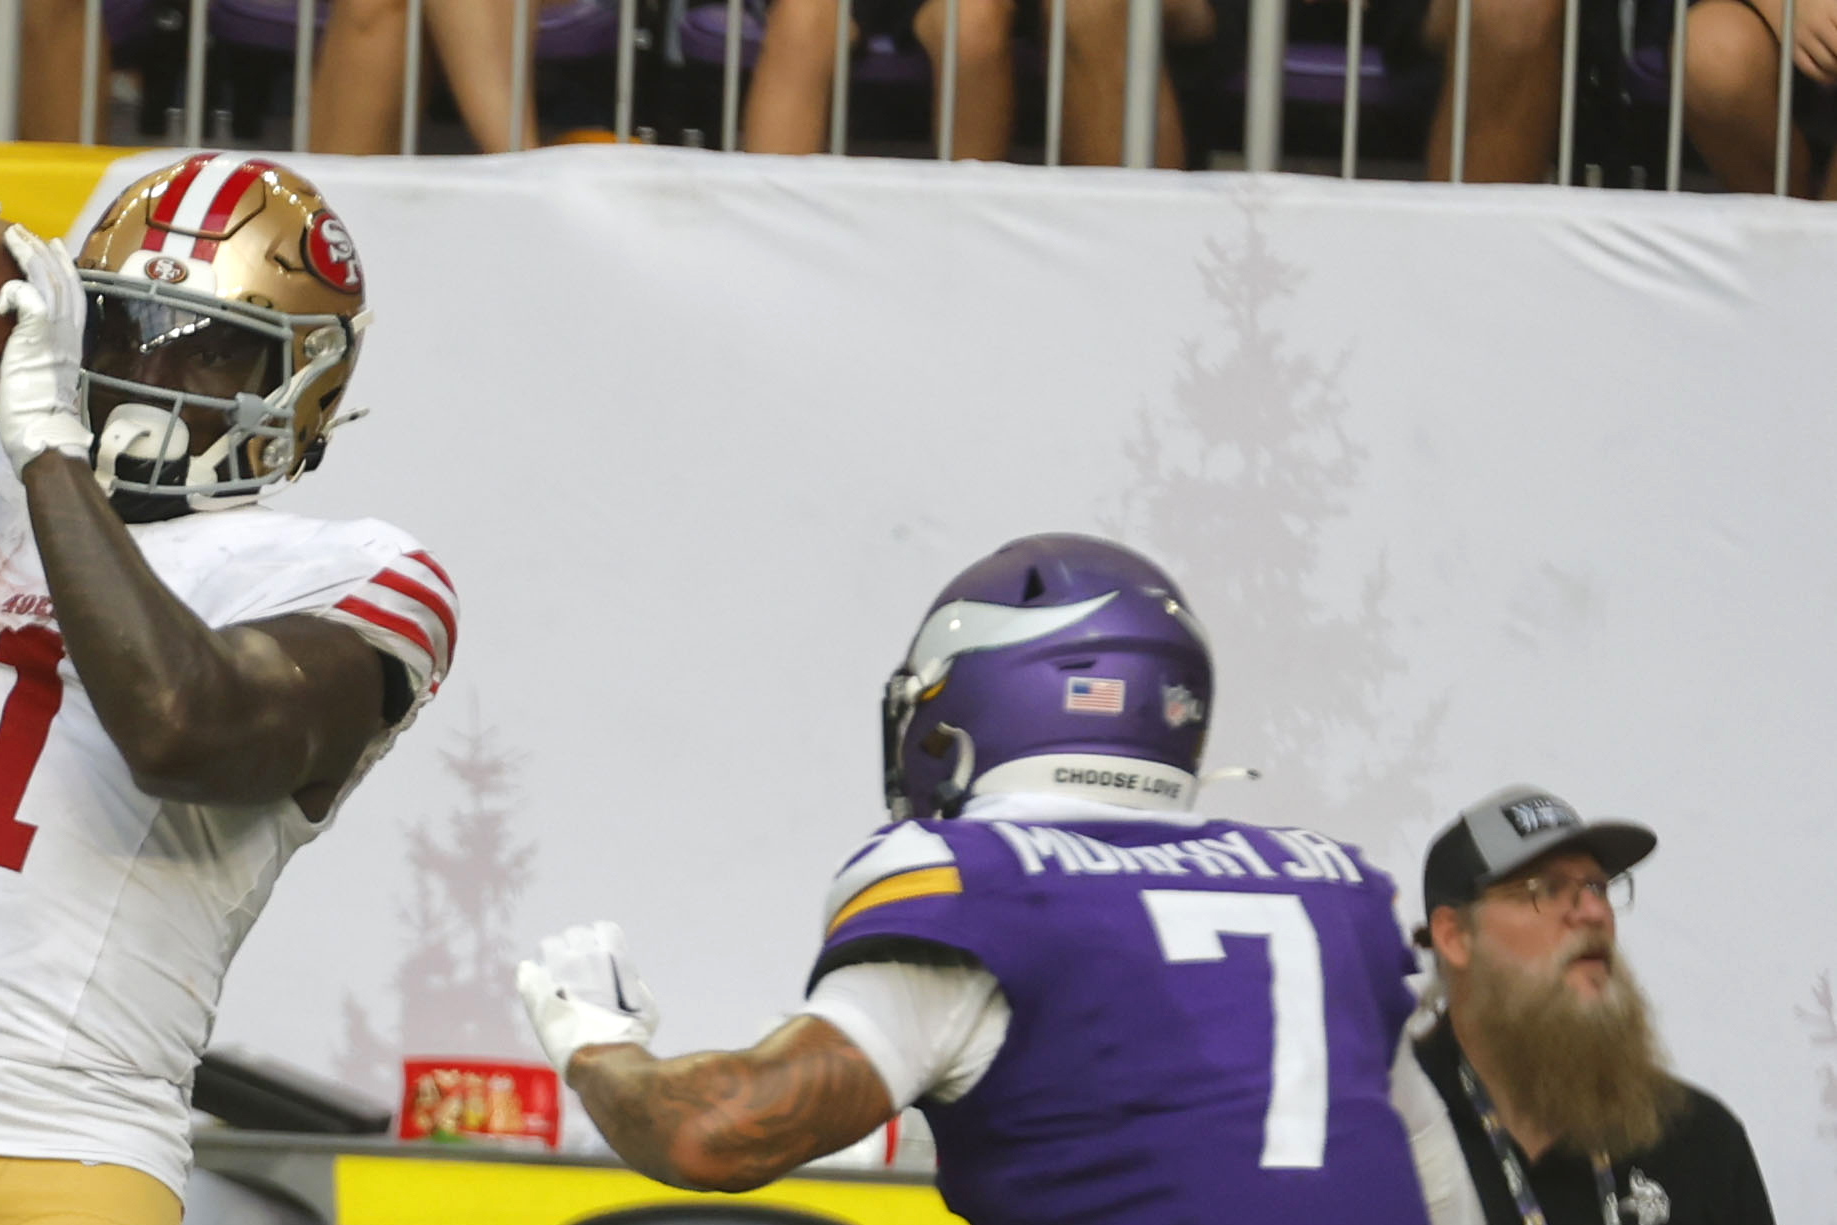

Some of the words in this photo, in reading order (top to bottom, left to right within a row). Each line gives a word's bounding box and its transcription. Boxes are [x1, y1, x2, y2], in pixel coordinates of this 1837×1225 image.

[1054, 766, 1140, 790] CHOOSE
[1142, 776, 1182, 799] LOVE
[991, 820, 1279, 877] MURPHY
[1138, 888, 1330, 1169] 7
